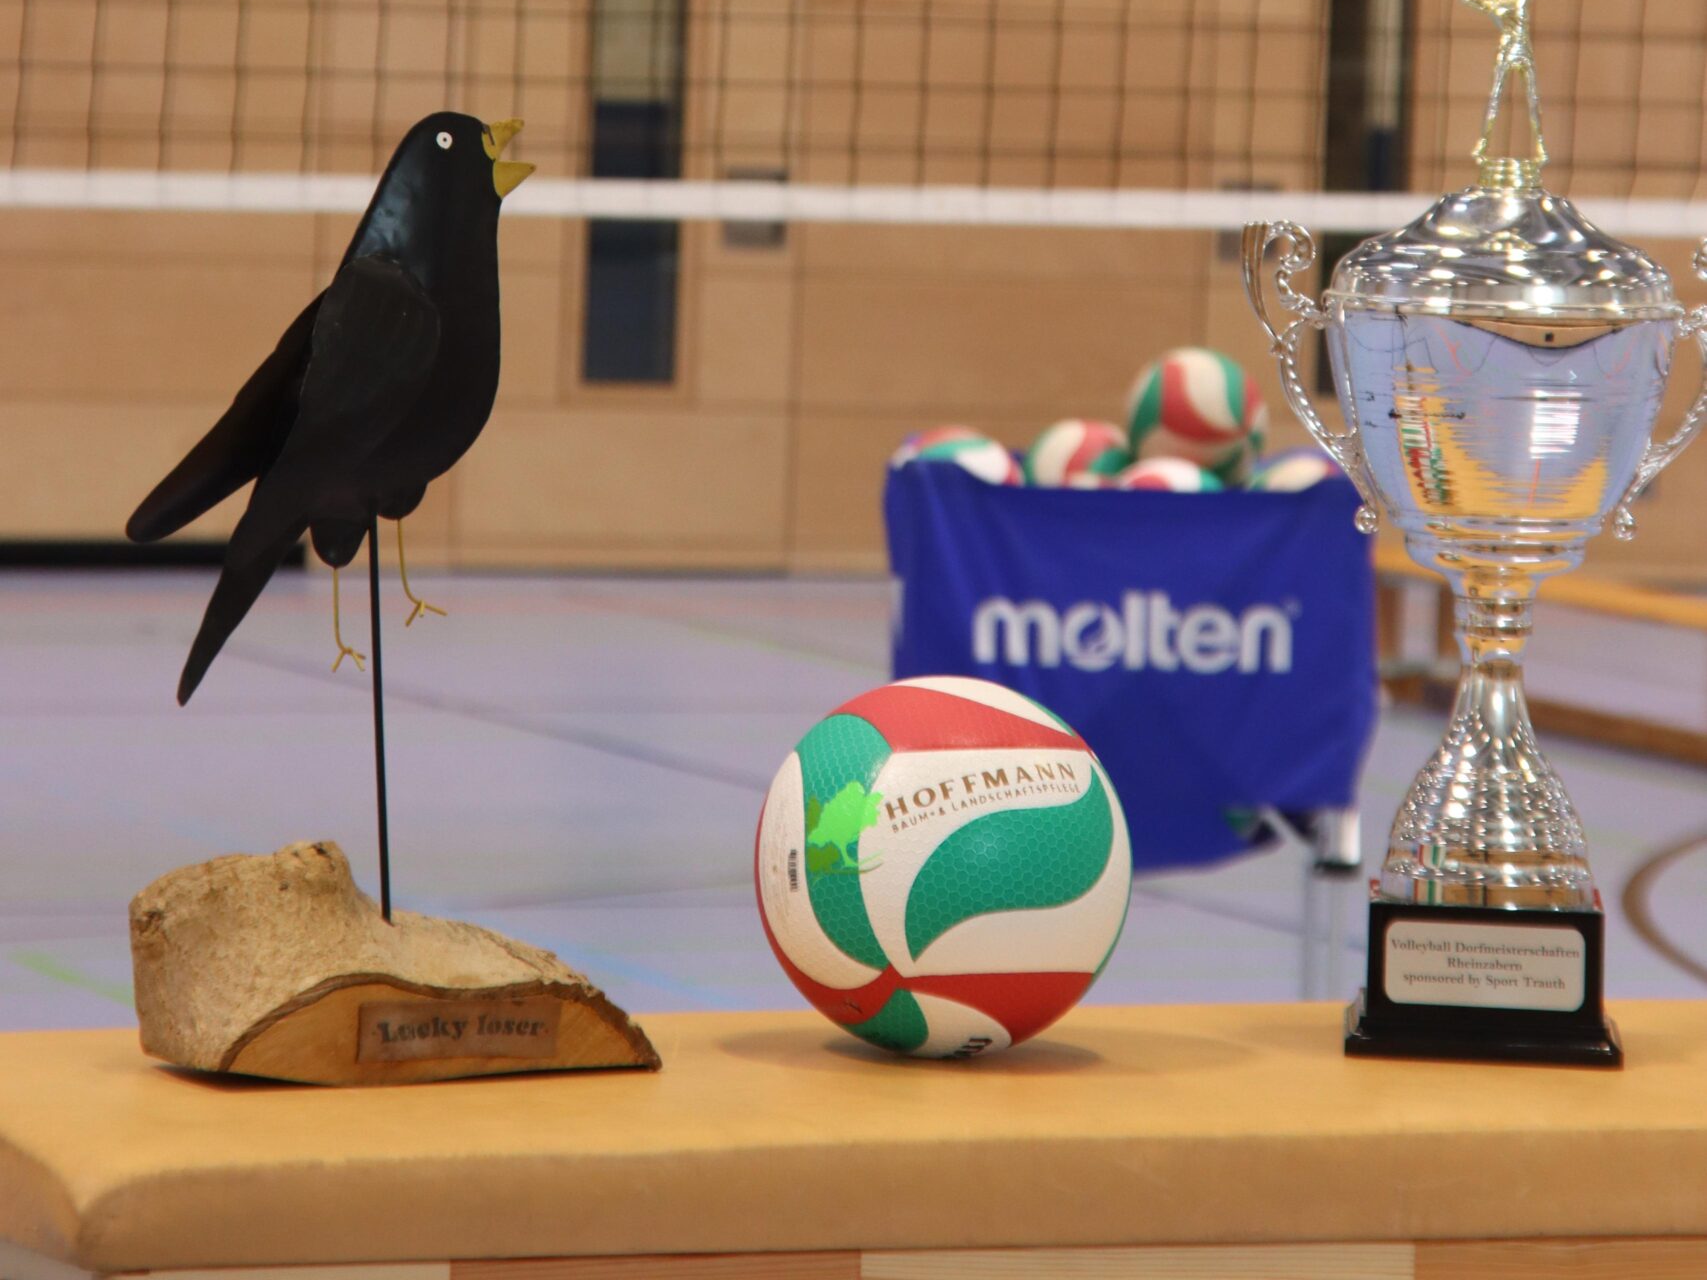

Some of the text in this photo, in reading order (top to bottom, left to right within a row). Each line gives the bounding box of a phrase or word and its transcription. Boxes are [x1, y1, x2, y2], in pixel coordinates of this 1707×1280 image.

[973, 589, 1293, 673] molten
[884, 762, 1077, 821] HOFFMANN
[951, 782, 1081, 812] LANDSCHAFTSPFLEGE
[1391, 938, 1580, 959] Volleyball Dorfmeisterschaften
[1447, 957, 1523, 972] Rheinzabern
[1403, 972, 1566, 990] sponsored by Sport Trauth
[377, 1016, 468, 1044] Lucky
